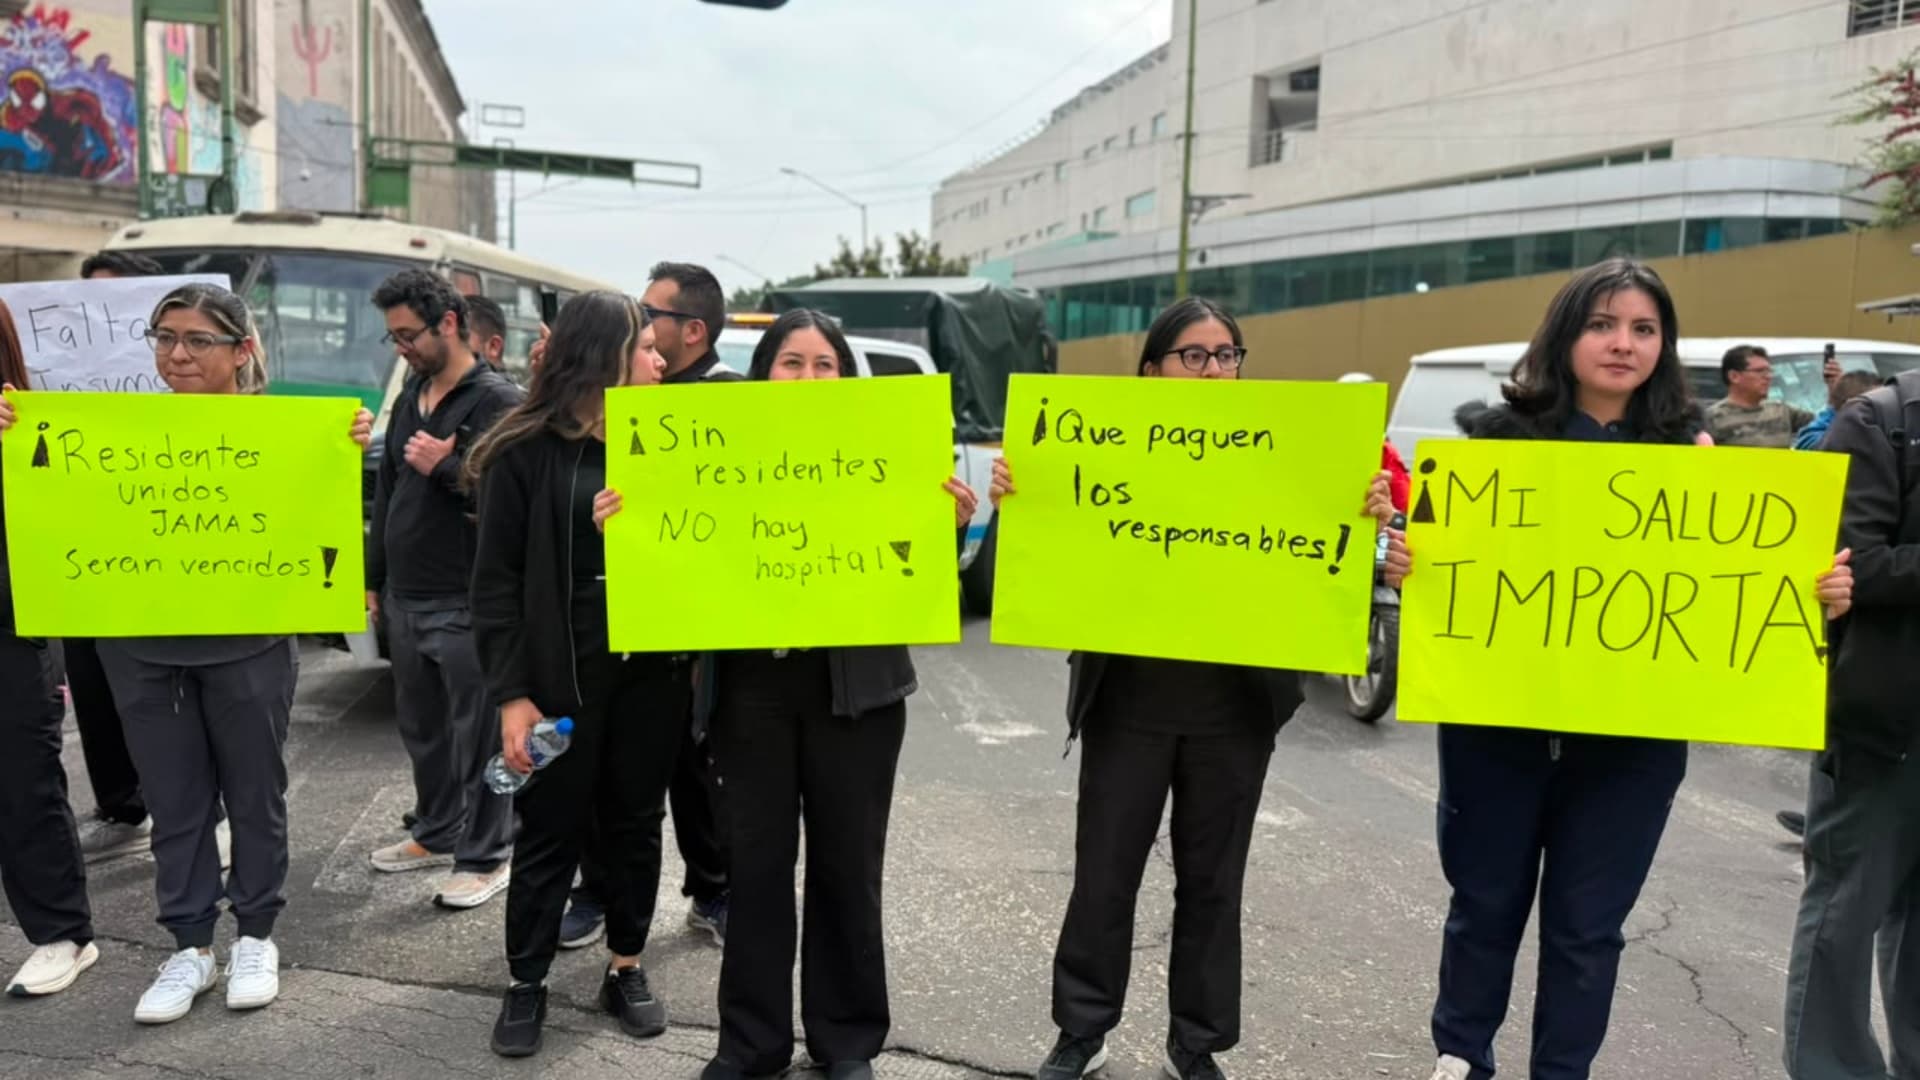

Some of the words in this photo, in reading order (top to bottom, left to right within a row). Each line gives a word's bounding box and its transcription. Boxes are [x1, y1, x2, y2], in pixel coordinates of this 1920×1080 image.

[28, 302, 149, 352] Falta
[30, 420, 261, 474] ¡Residentes
[628, 413, 726, 457] ¡Sin
[1031, 396, 1127, 447] ¡Que
[1146, 423, 1275, 462] paguen
[695, 448, 888, 486] residentes
[1072, 463, 1134, 508] los
[117, 475, 229, 506] unidos
[1603, 469, 1798, 550] SALUD
[150, 508, 267, 537] JAMAS
[658, 508, 717, 543] NO
[751, 511, 809, 552] hay
[180, 545, 340, 590] vencidos!
[755, 538, 915, 587] hospital!
[1107, 518, 1353, 577] responsables!
